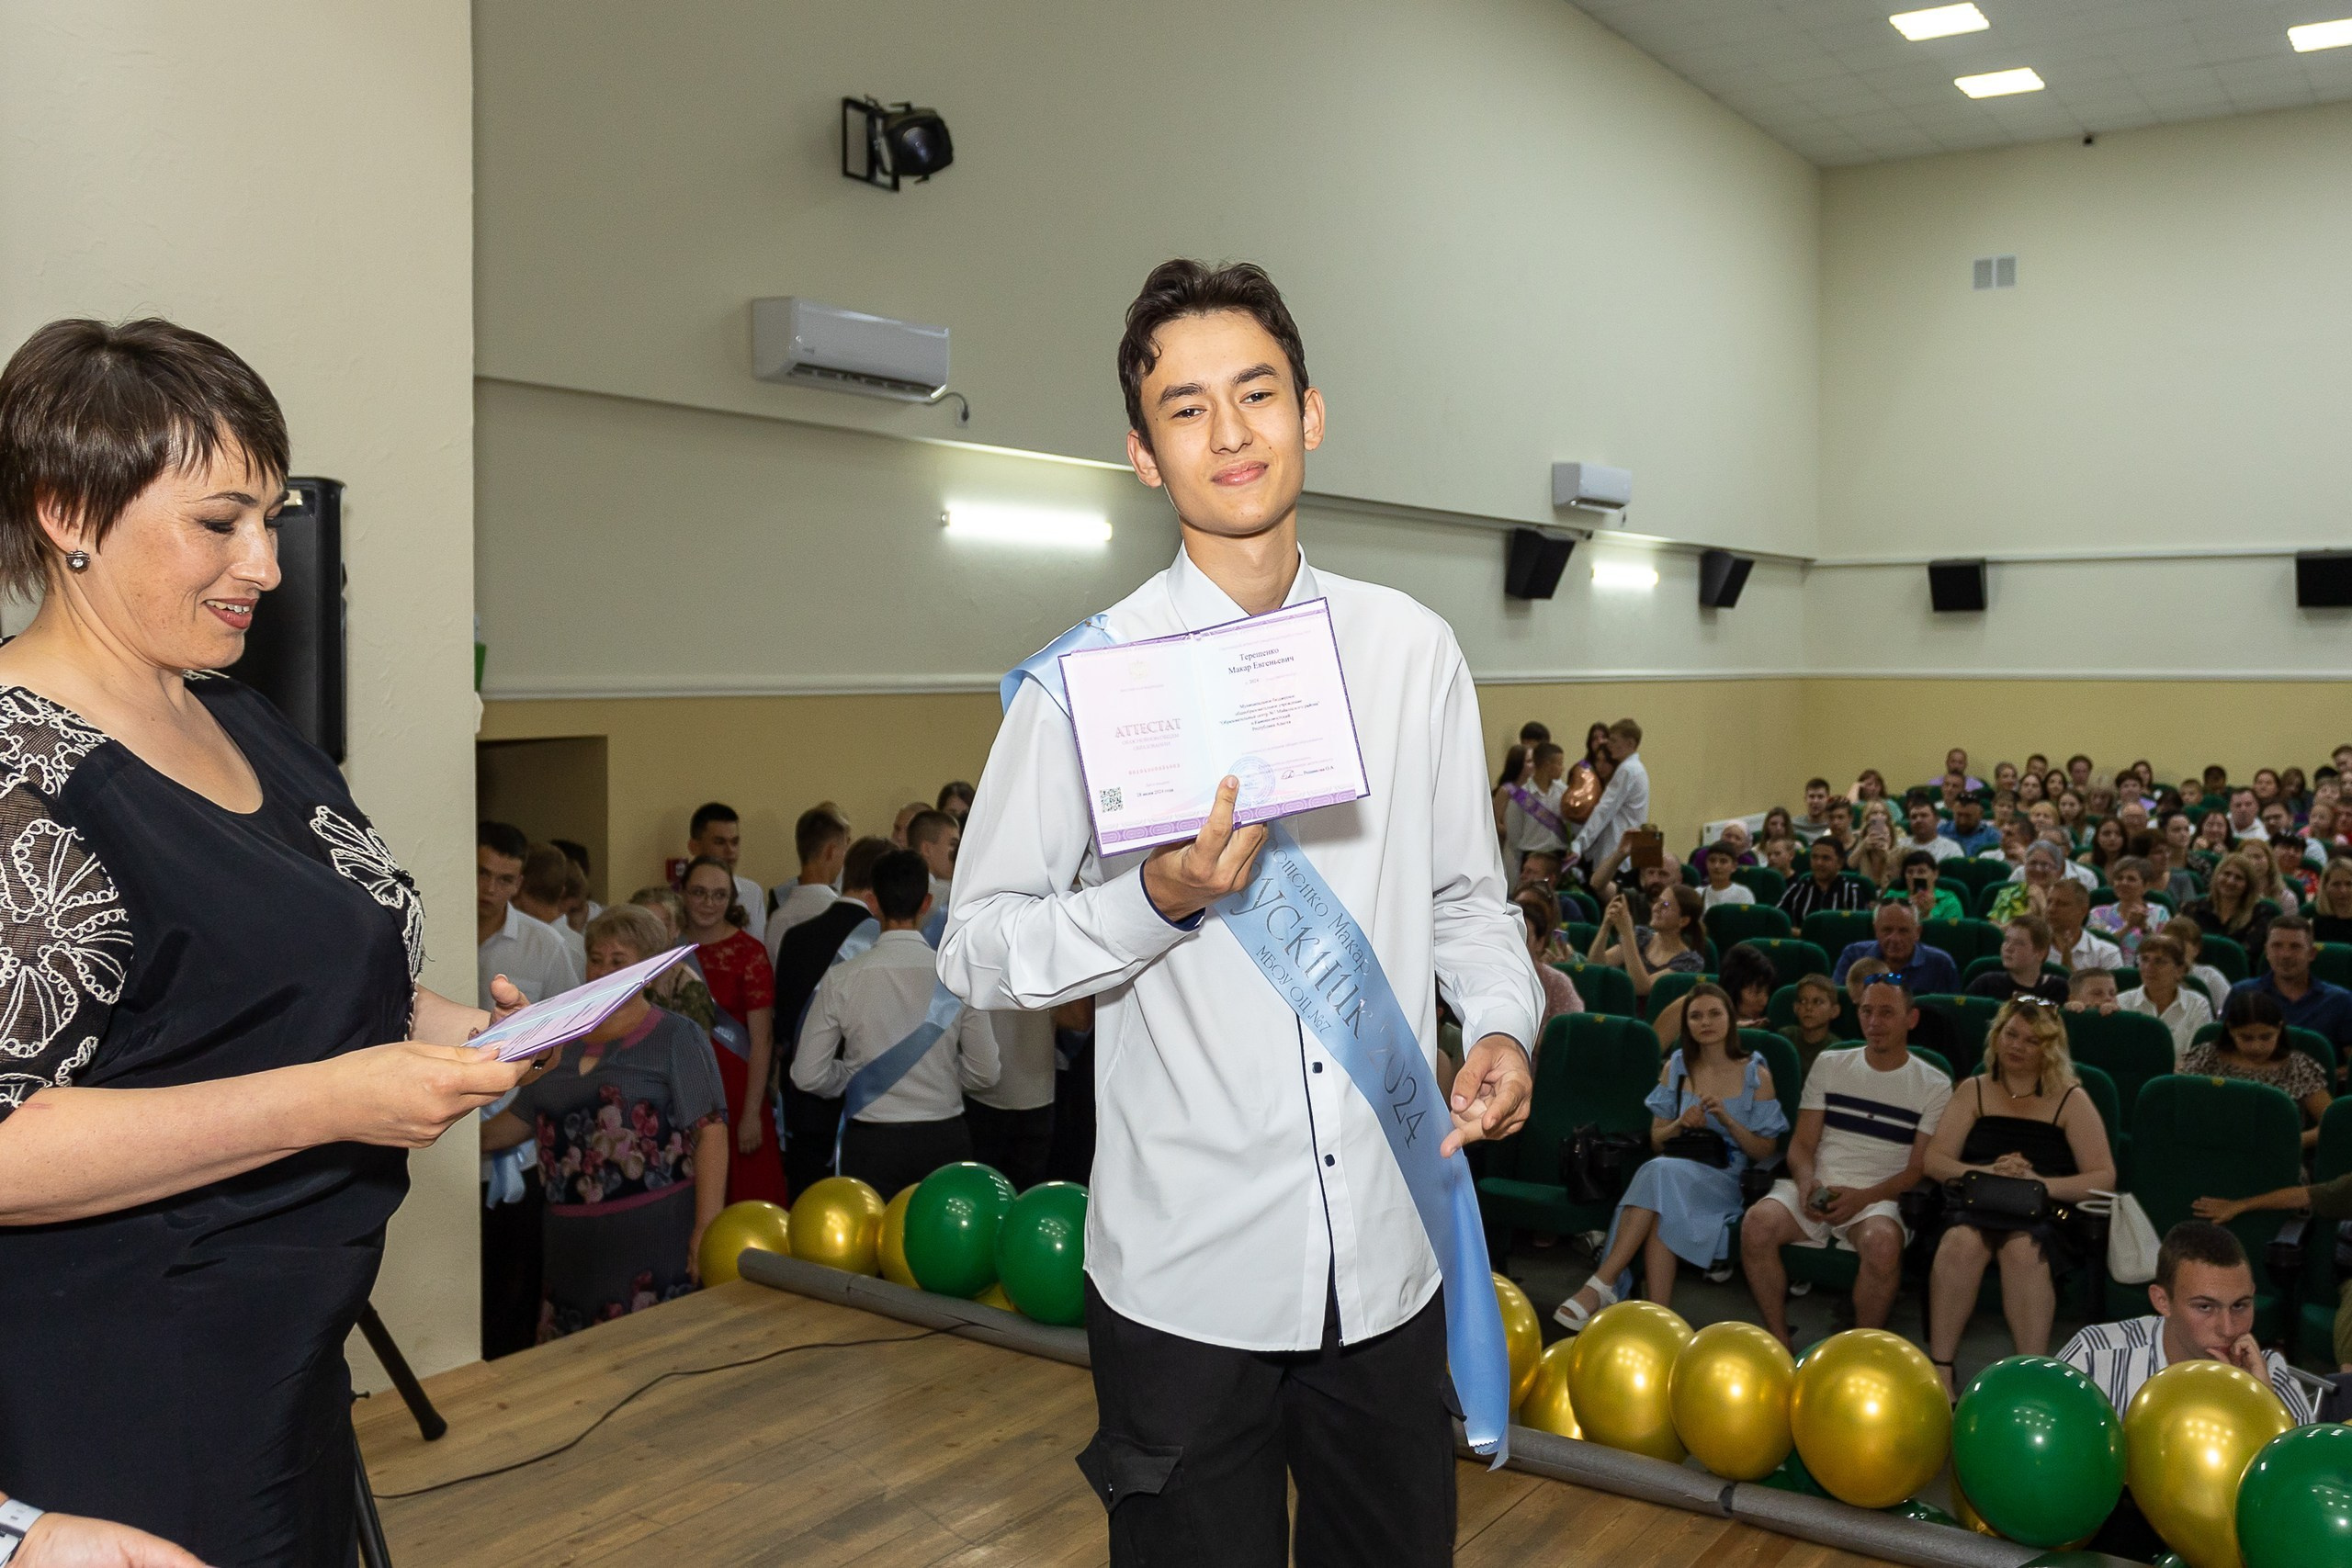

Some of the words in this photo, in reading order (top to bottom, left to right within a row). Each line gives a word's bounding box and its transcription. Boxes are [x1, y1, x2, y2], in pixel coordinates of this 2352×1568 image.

[1239, 648, 1280, 661] Терещенко
[1227, 665, 1252, 675] Макар
[1115, 717, 1182, 739] АТТЕСТАТ
[1328, 912, 1371, 976] Макар
[1256, 940, 1293, 986] МБОУ
[1289, 986, 1313, 1015] ОЦ
